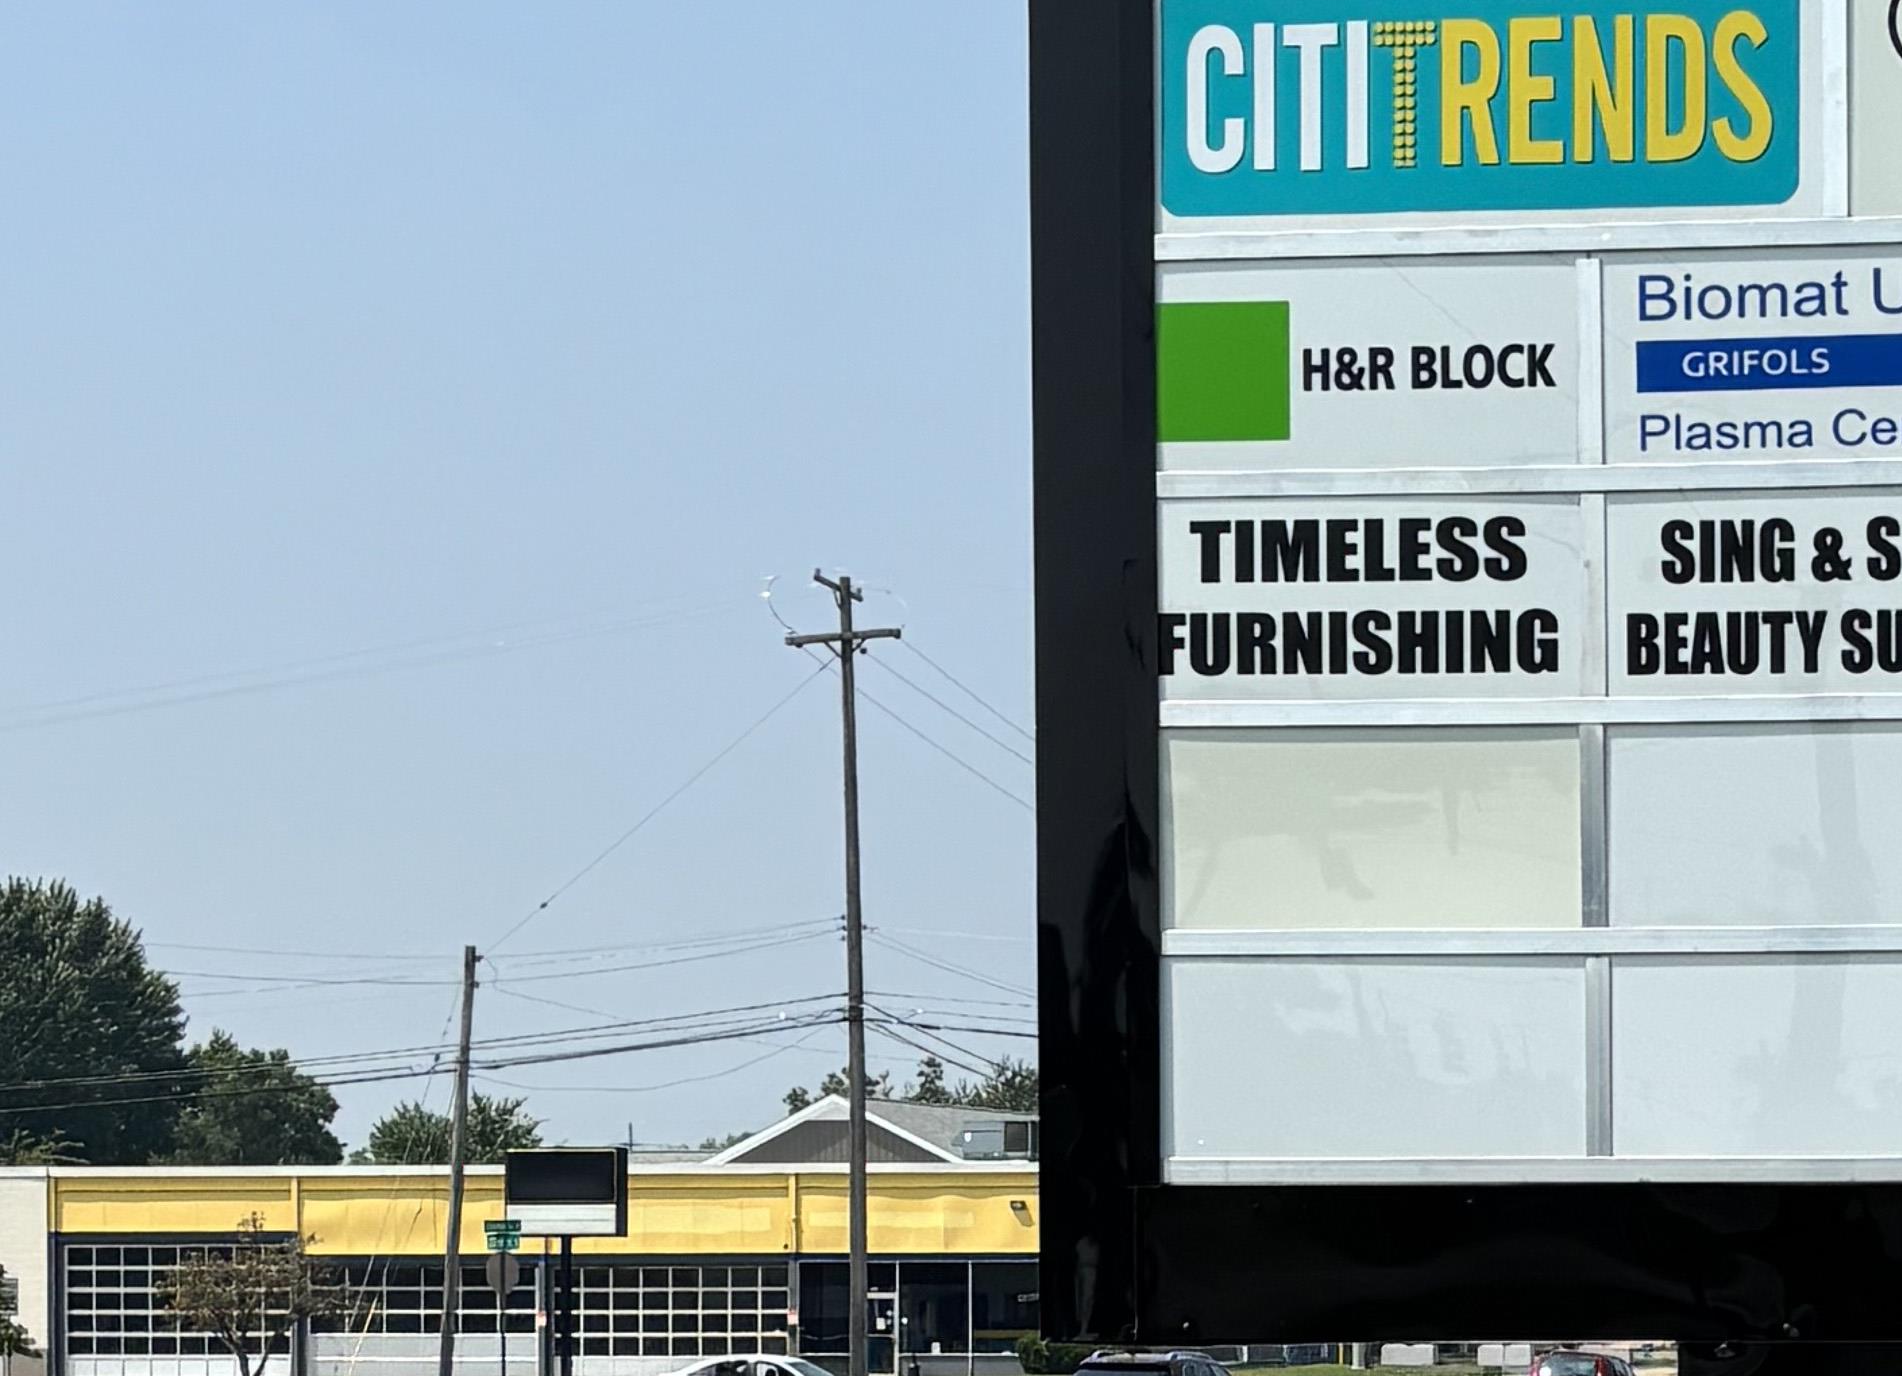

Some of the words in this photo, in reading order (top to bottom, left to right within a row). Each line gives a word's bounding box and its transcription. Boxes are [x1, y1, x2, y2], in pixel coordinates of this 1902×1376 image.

[1637, 269, 1850, 322] Biomat
[1302, 346, 1396, 392] H&R
[1410, 343, 1557, 390] BLOCK
[1681, 347, 1831, 378] GRIFOLS
[1639, 412, 1814, 452] Plasma
[1189, 515, 1528, 584] TIMELESS
[1659, 517, 1796, 585] SING
[1810, 526, 1853, 583] &
[1157, 608, 1560, 677] FURNISHING
[1626, 609, 1828, 676] BEAUTY
